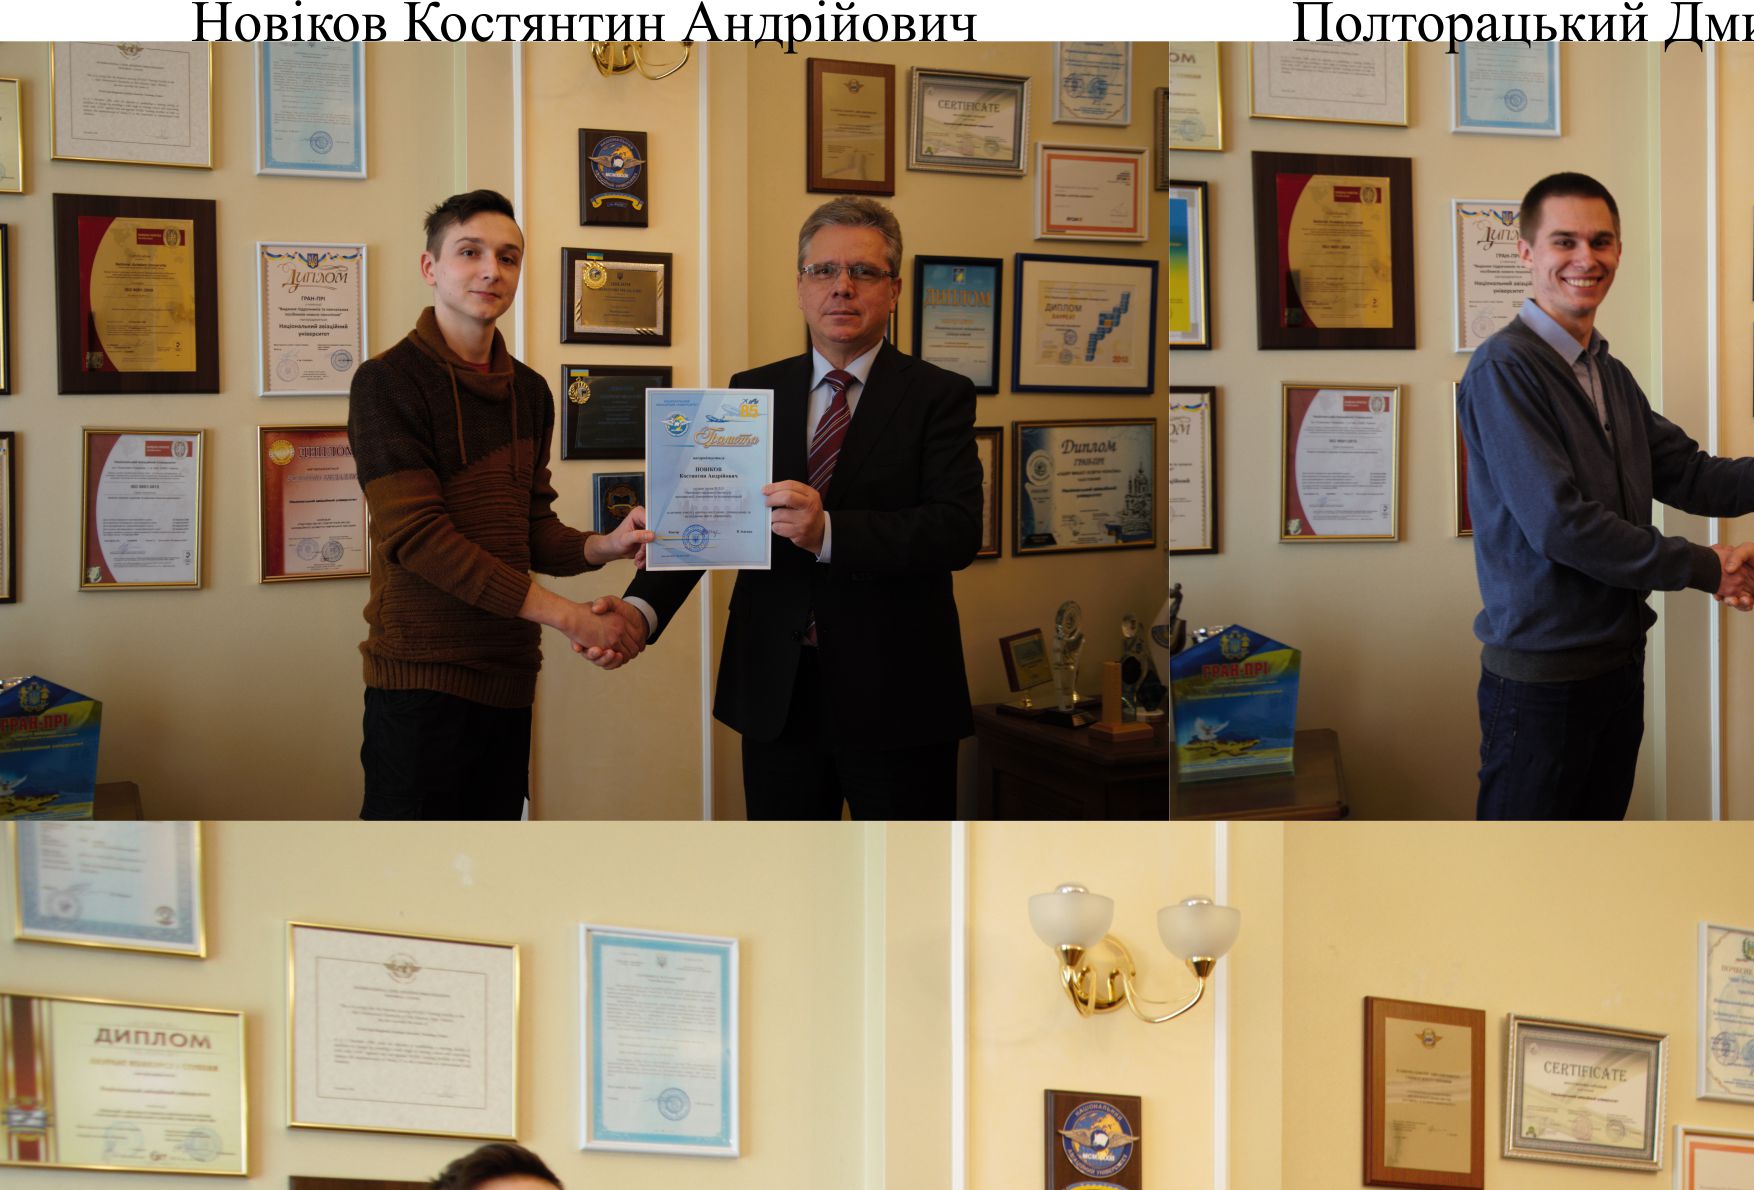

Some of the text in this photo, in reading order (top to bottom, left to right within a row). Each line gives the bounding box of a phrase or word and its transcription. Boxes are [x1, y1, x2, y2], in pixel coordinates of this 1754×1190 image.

[938, 100, 1000, 113] CERTIFICATE
[1045, 303, 1082, 313] ДИПЛОМ
[1061, 439, 1117, 454] Диплом
[1203, 661, 1269, 679] ГРАН-ПРІ
[1, 713, 69, 736] ГРАН-ПРІ
[94, 1028, 212, 1049] ДИПЛОМ
[1543, 1061, 1628, 1083] CERTIFICATE
